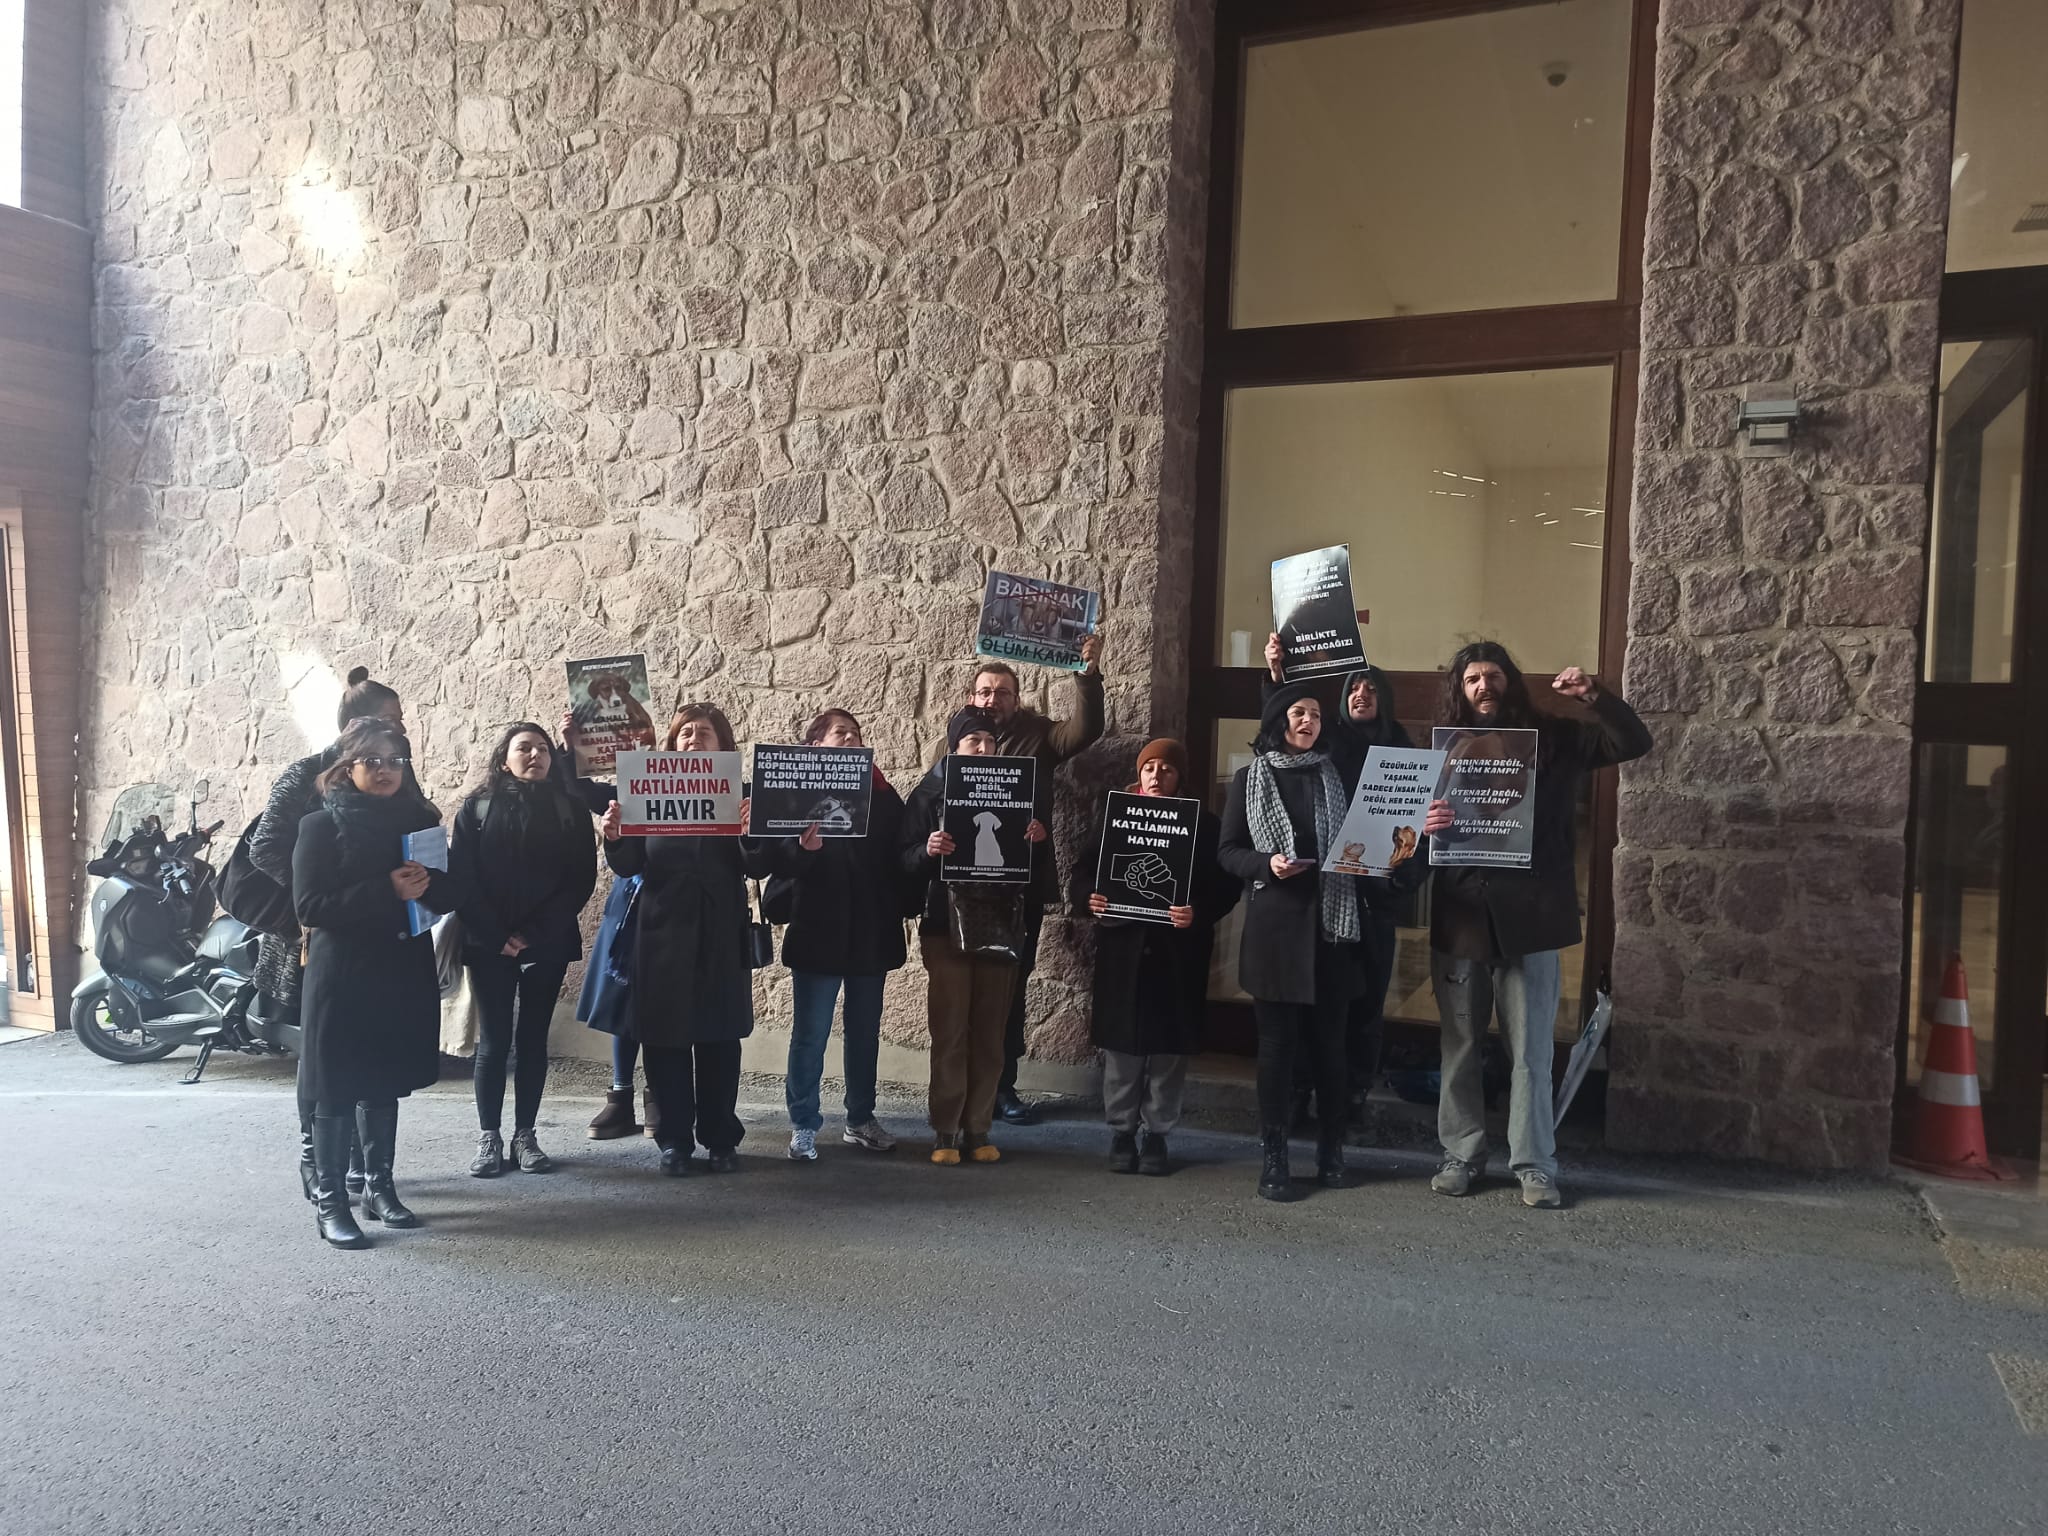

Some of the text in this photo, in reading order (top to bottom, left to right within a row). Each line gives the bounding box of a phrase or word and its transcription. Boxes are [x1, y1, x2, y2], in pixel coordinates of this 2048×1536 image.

[996, 579, 1085, 611] BARINAK
[1295, 629, 1337, 643] BİRLİKTE
[981, 638, 1027, 659] ÖLÜM
[1288, 638, 1353, 655] YAŞAYACAĞIZ!
[757, 751, 818, 762] KATİLLERİN
[646, 758, 713, 774] HAYVAN
[757, 760, 868, 772] KÖPEKLERİN KAFESTE
[1379, 760, 1418, 770] ÖZGÜRLÜK
[1450, 758, 1524, 768] BARINAK DEĞİL,
[765, 770, 860, 781] OLDUĞU BU DÜZENİ
[961, 767, 1021, 776] SORUMLULAR
[1455, 766, 1519, 775] ÖLÜM KAMPI!
[764, 780, 861, 790] KABUL ETMİYORUZ!
[963, 775, 1018, 784] HAYVANLAR
[630, 776, 730, 795] KATLİAMINA
[976, 782, 1005, 792] DEĞİL,
[1362, 784, 1432, 795] SADECE İNSAN İÇİN
[968, 790, 1012, 800] GÖREVİNİ
[1451, 787, 1523, 798] ÖTENAZİ DEĞİL,
[1363, 795, 1387, 803] DEĞİL
[1463, 796, 1510, 805] KATLİAM!
[646, 799, 716, 820] HAYIR
[1127, 806, 1178, 820] HAYVAN
[1368, 806, 1416, 817] İÇİN HAKTIR!
[1112, 819, 1189, 836] KATLİAMINA
[1492, 820, 1523, 829] DEĞİL,
[1459, 826, 1511, 835] SOYKIRIM!
[1127, 835, 1170, 848] HAYIR!
